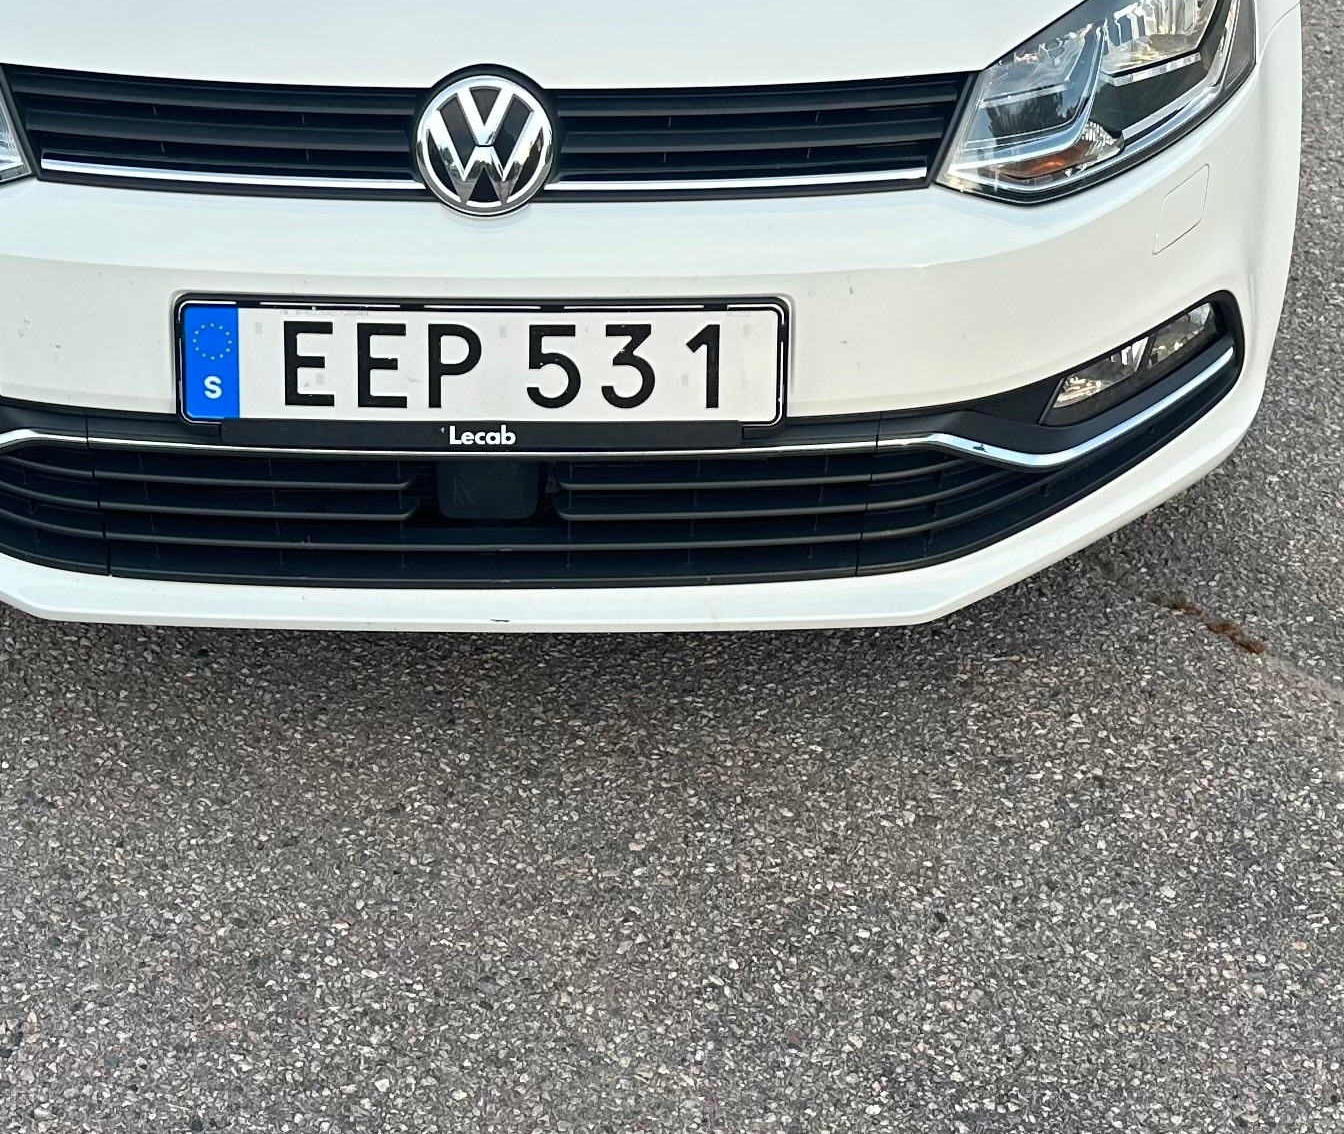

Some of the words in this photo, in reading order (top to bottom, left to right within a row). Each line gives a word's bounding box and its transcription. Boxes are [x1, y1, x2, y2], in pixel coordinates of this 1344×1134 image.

[282, 320, 483, 410] EEP
[525, 323, 720, 410] 531
[204, 375, 223, 399] S
[449, 424, 517, 445] Lecab
